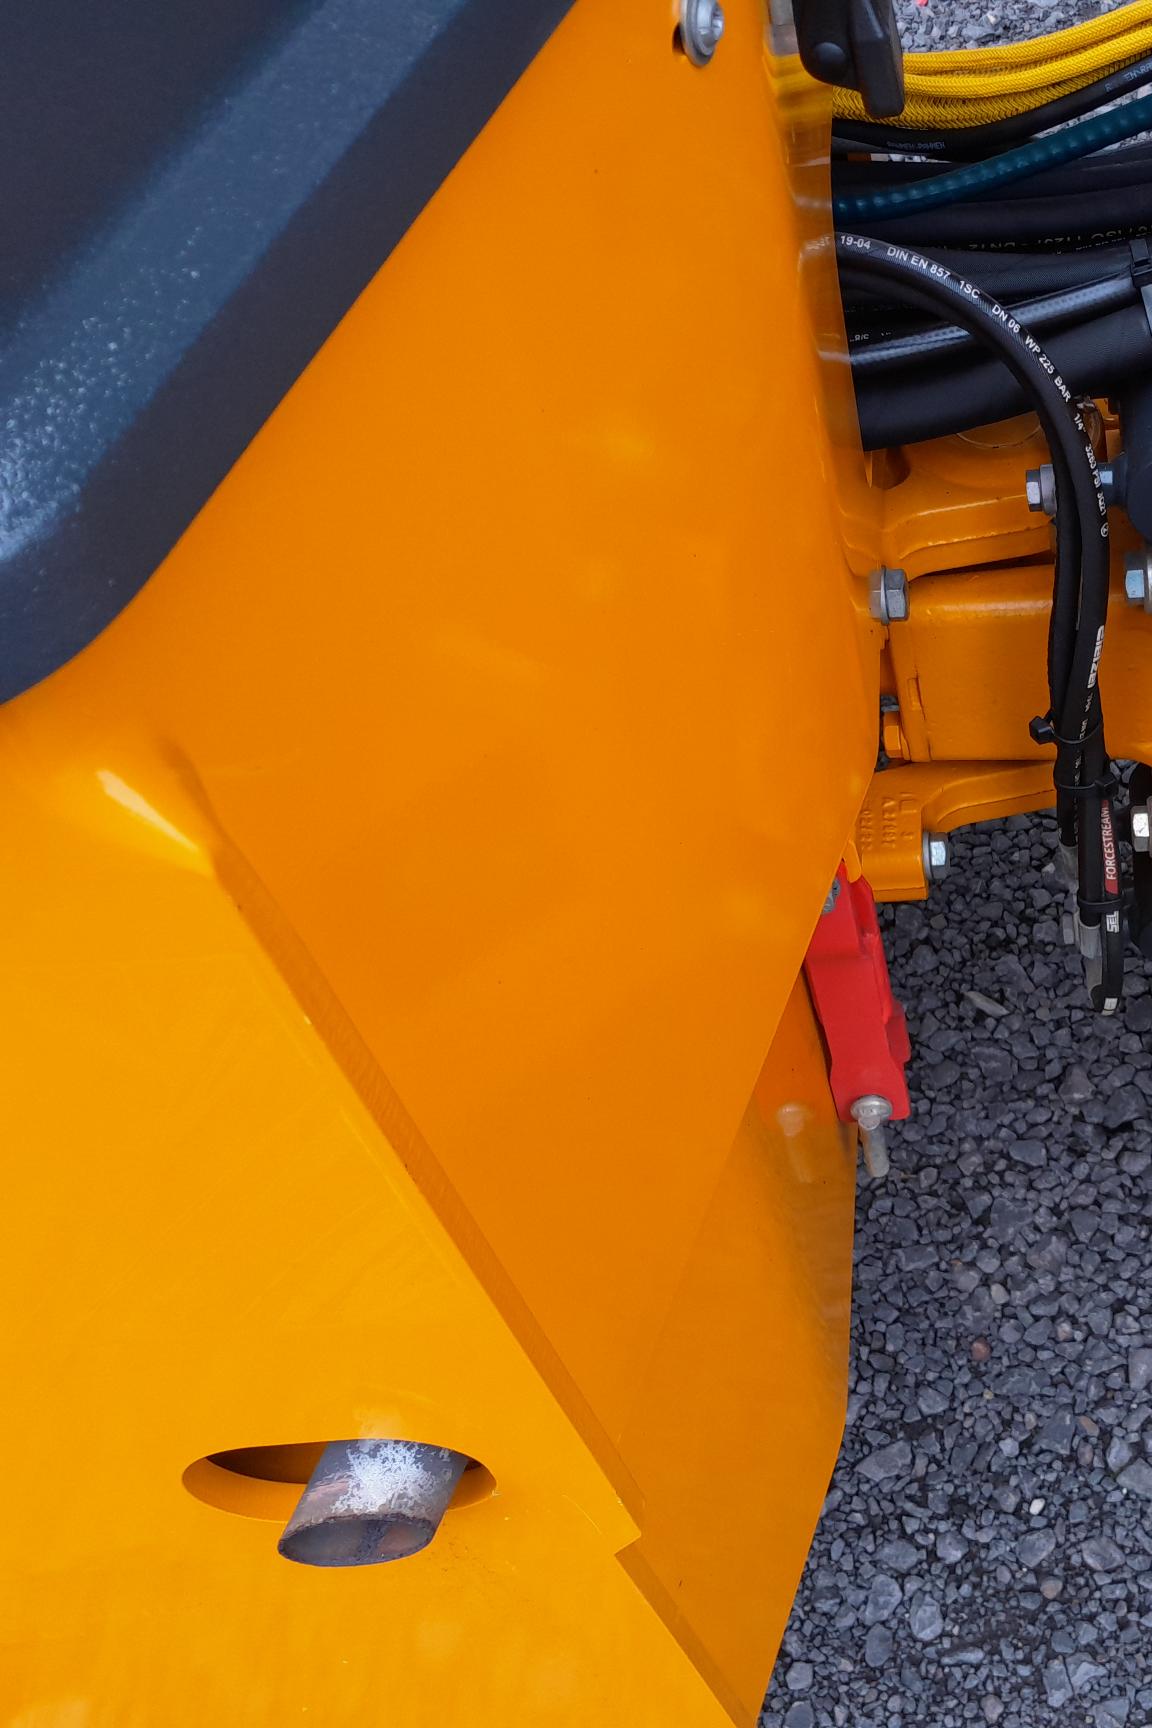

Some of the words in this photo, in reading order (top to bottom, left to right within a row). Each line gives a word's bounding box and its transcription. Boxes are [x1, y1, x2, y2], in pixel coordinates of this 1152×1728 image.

[840, 235, 871, 250] 19-04
[887, 246, 909, 262] DIN
[910, 255, 929, 270] EN
[930, 264, 951, 280] 857
[959, 280, 980, 299] 1SC
[992, 304, 1009, 322] DN
[1008, 319, 1021, 334] 06
[1025, 335, 1041, 354] WP
[1039, 354, 1055, 375] 225
[1054, 375, 1071, 403] BAR
[1101, 807, 1117, 880] FORCESTREAM
